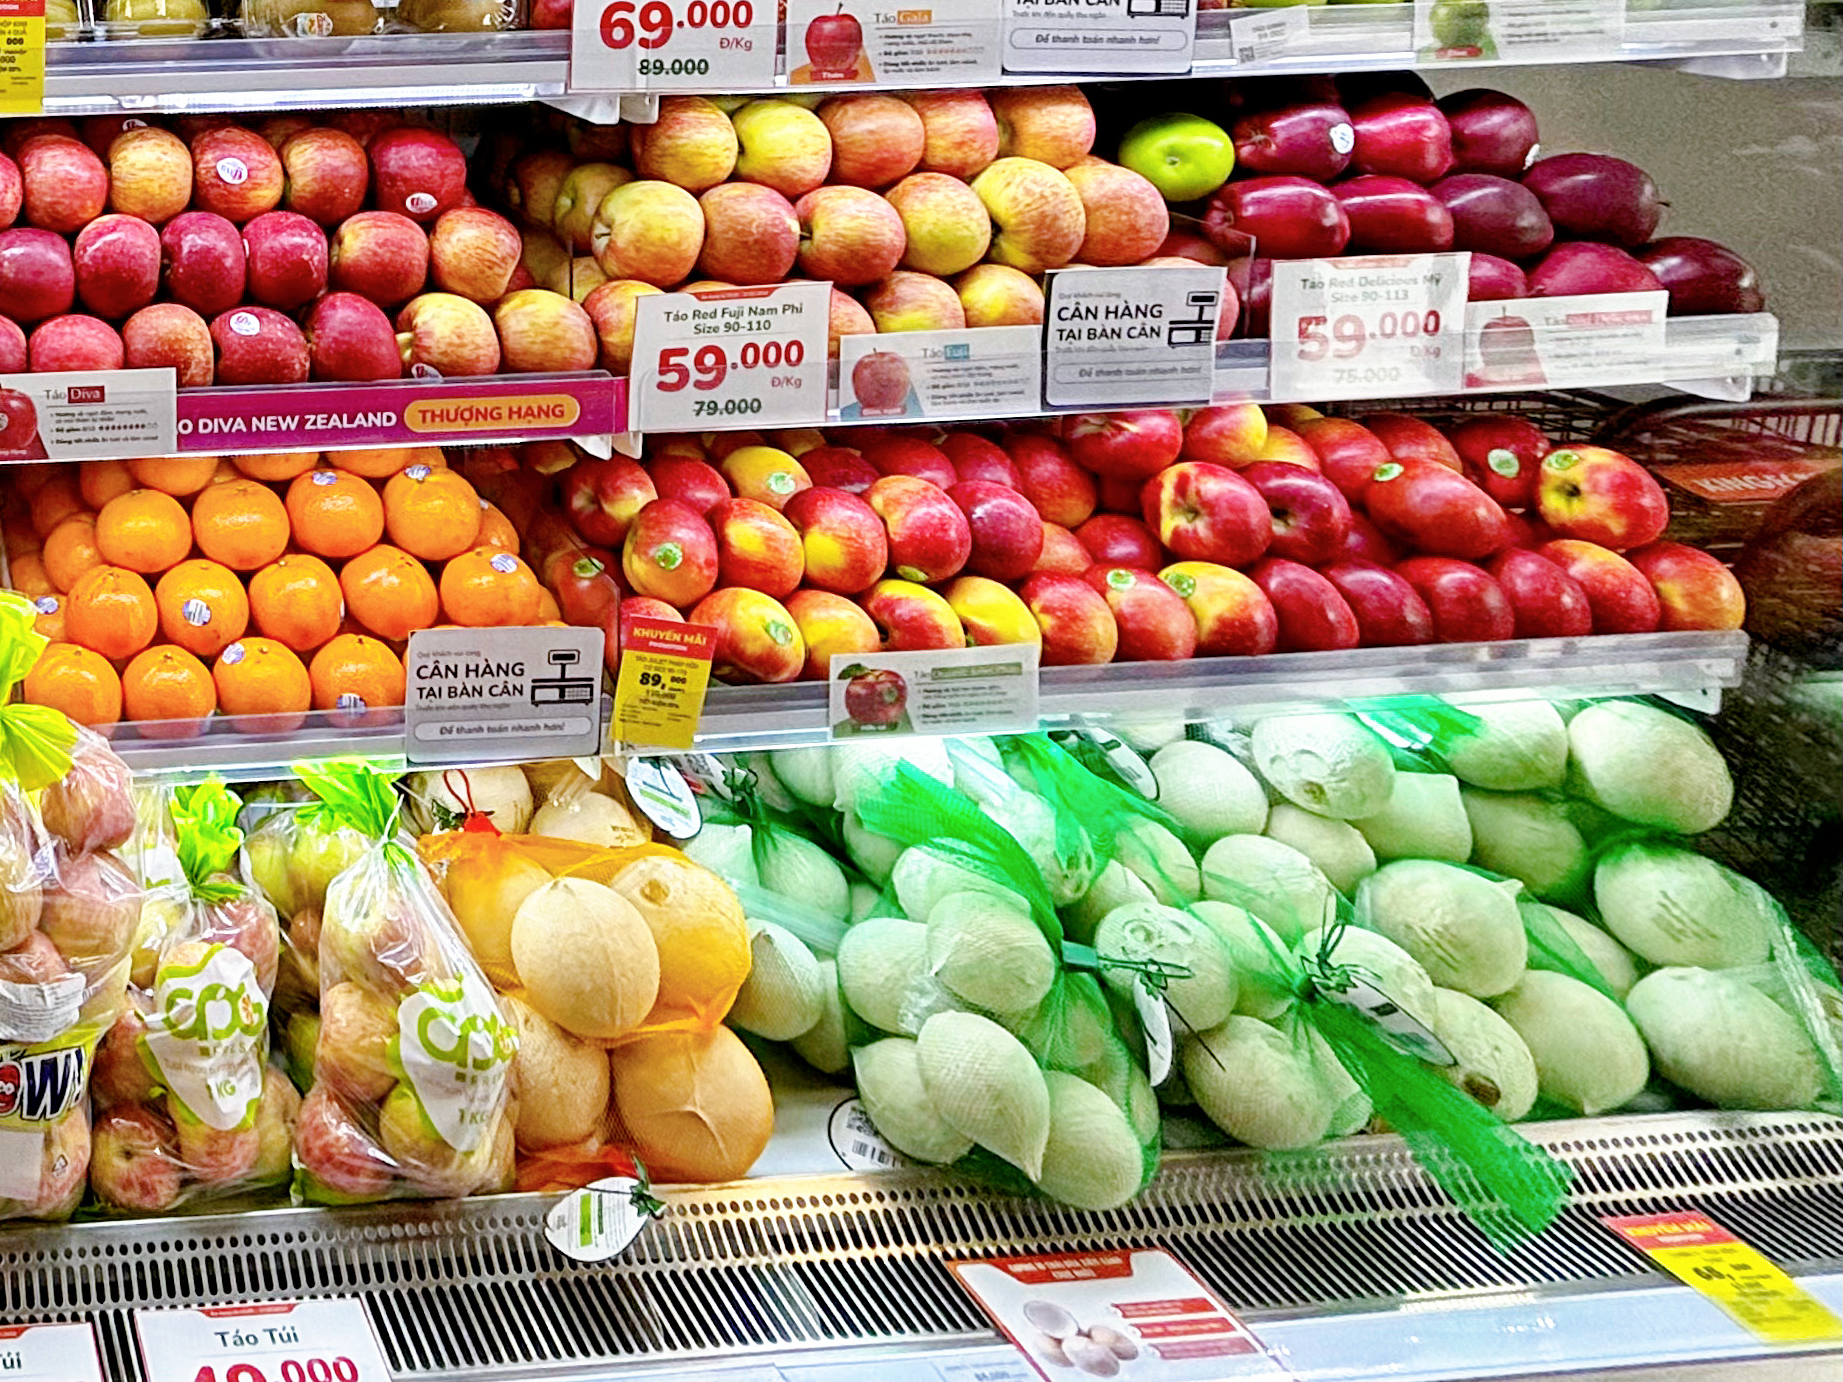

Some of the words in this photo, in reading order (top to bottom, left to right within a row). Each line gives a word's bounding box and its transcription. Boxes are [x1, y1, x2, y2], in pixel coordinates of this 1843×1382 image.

[874, 12, 896, 24] Táo
[719, 37, 753, 51] Đ/Kg
[1035, 33, 1050, 44] Để
[1052, 34, 1080, 44] thanh
[1082, 34, 1104, 44] toán
[1106, 35, 1136, 44] nhanh
[638, 58, 710, 75] 89.000
[664, 309, 688, 322] Táo
[692, 308, 717, 320] Red
[721, 306, 745, 319] Fuji
[748, 305, 778, 316] Nam
[782, 303, 803, 314] Phi
[1057, 303, 1101, 321] CÂN
[1105, 301, 1163, 320] HÀNG
[693, 323, 720, 334] Size
[724, 320, 771, 333] 90-110
[1057, 328, 1082, 347] TẠI
[1087, 324, 1121, 341] BÀN
[1126, 322, 1161, 339] CÂN
[921, 347, 943, 358] Táo
[771, 375, 802, 389] Đ/Kg
[43, 387, 67, 401] Táo
[69, 388, 101, 400] Diva
[418, 404, 503, 428] THƯỢNG
[507, 403, 565, 426] HẠNG
[692, 398, 762, 416] 79.000
[198, 416, 246, 434] DIVA
[251, 414, 299, 432] NEW
[304, 411, 397, 430] ZEALAND
[633, 627, 681, 643] KHUYẾN
[684, 633, 707, 646] MÃI
[416, 661, 459, 680] CÂN
[465, 659, 525, 677] HÀNG
[417, 686, 443, 704] TẠI
[447, 682, 484, 699] BÀN
[488, 681, 524, 698] CÂN
[213, 1327, 259, 1348] Táo
[263, 1324, 300, 1345] Túi
